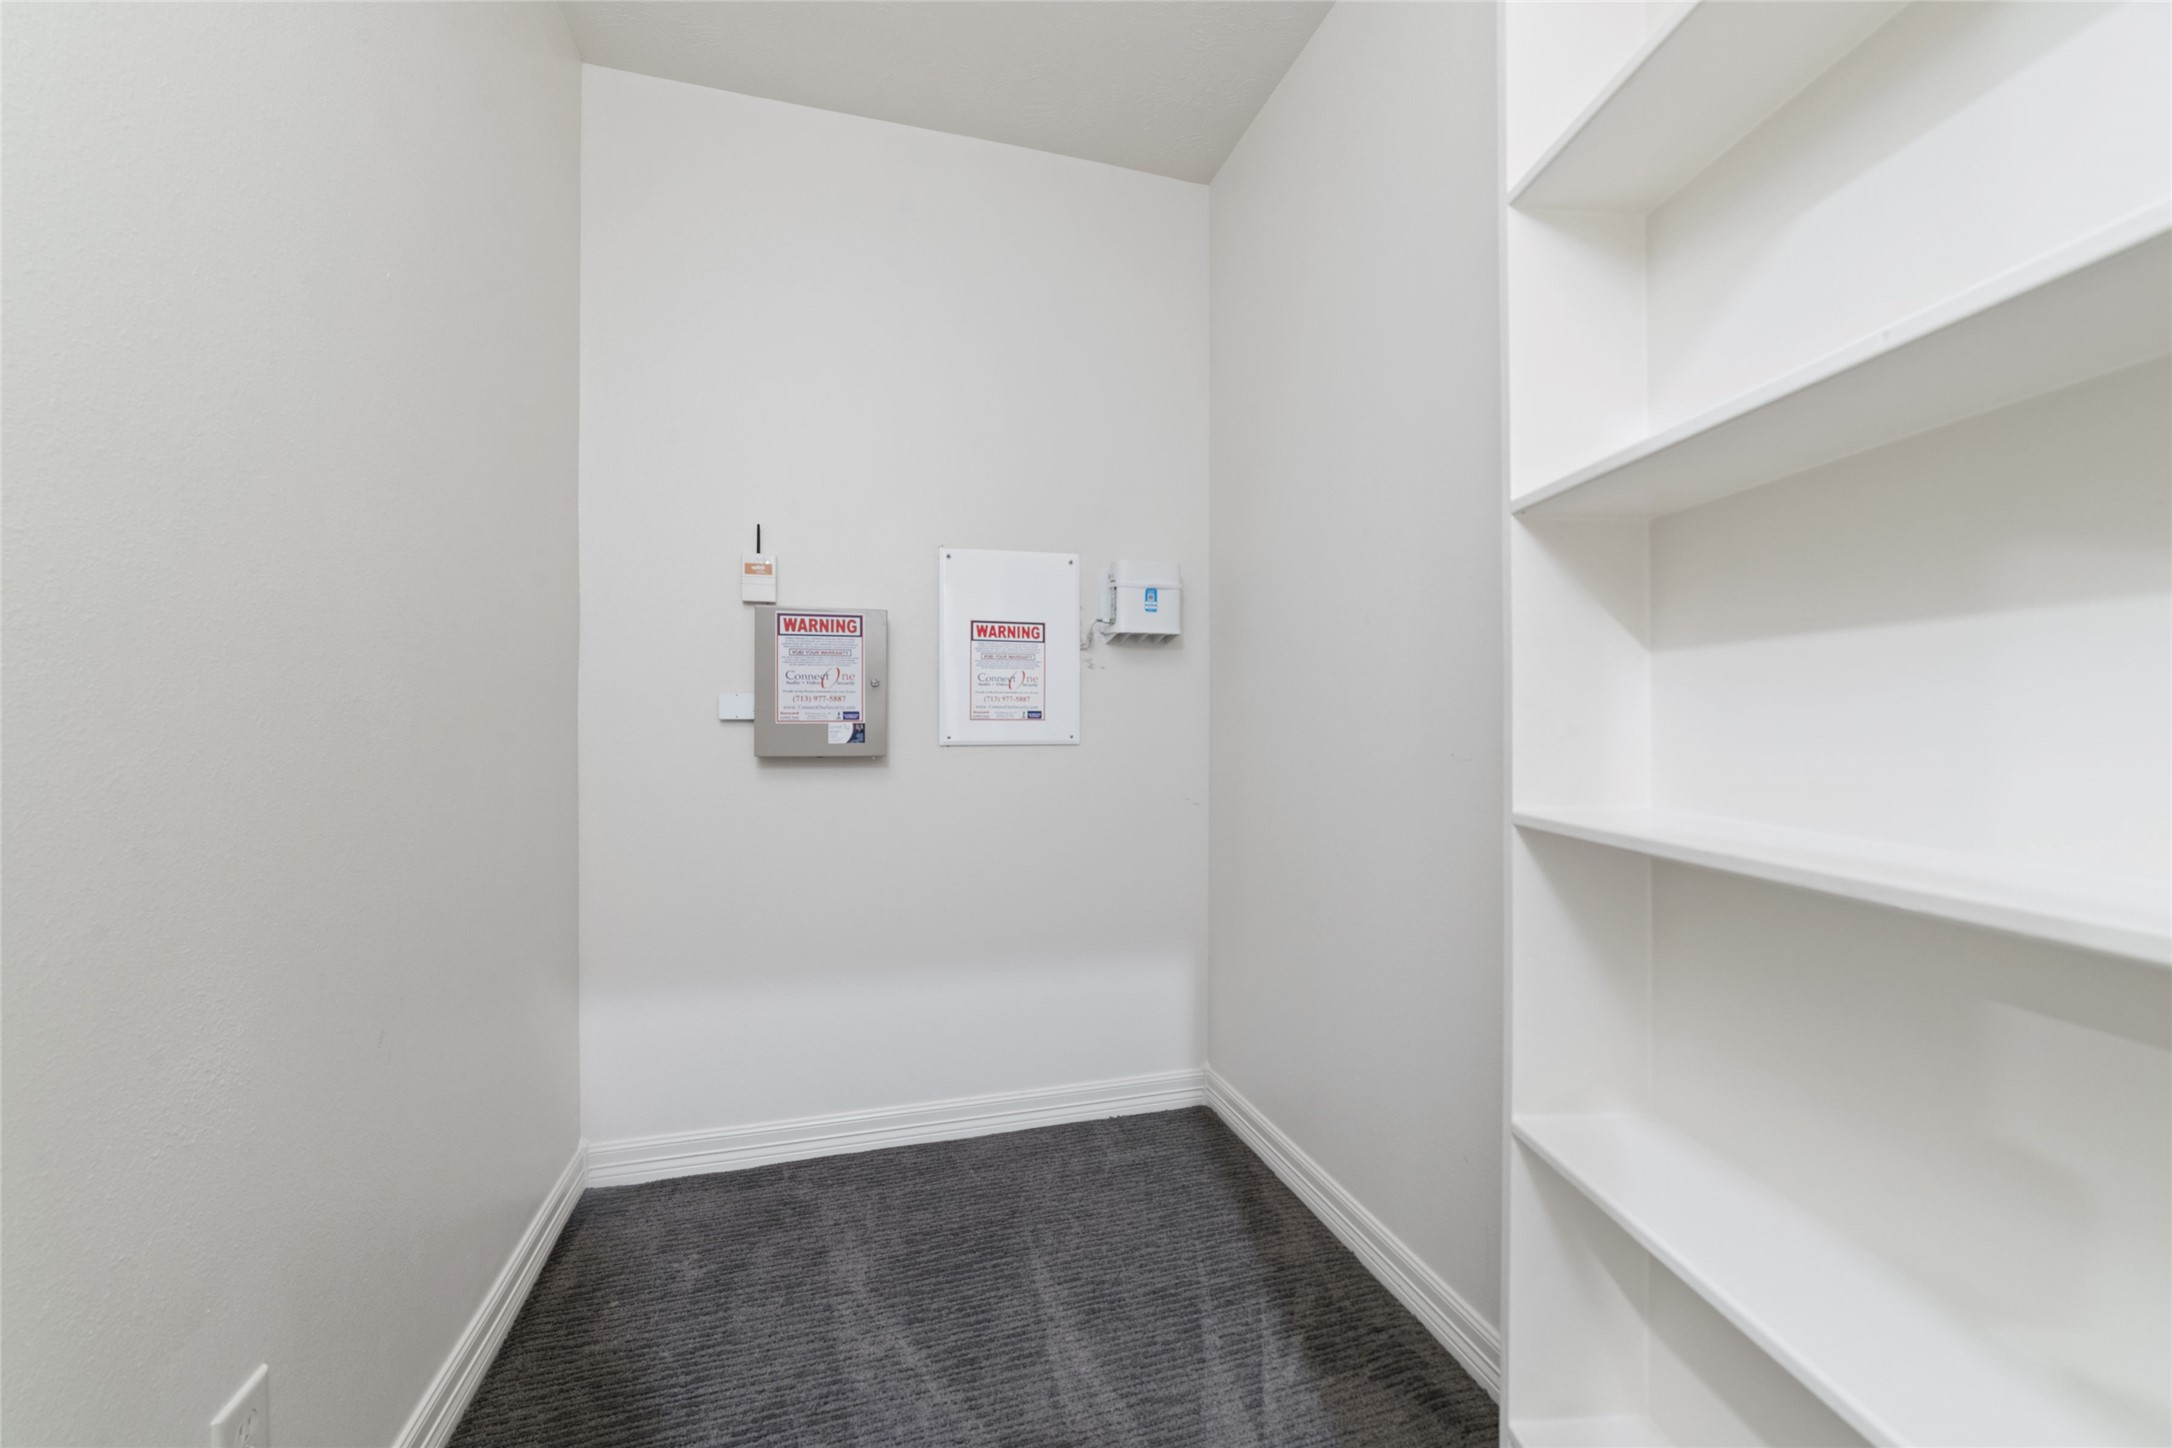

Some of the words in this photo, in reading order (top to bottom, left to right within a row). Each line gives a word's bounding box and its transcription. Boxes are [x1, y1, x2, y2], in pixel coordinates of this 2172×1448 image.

[783, 617, 857, 633] WARNING
[976, 624, 1041, 639] WARNING
[792, 695, 811, 703] (713)
[984, 695, 1000, 703] (713)
